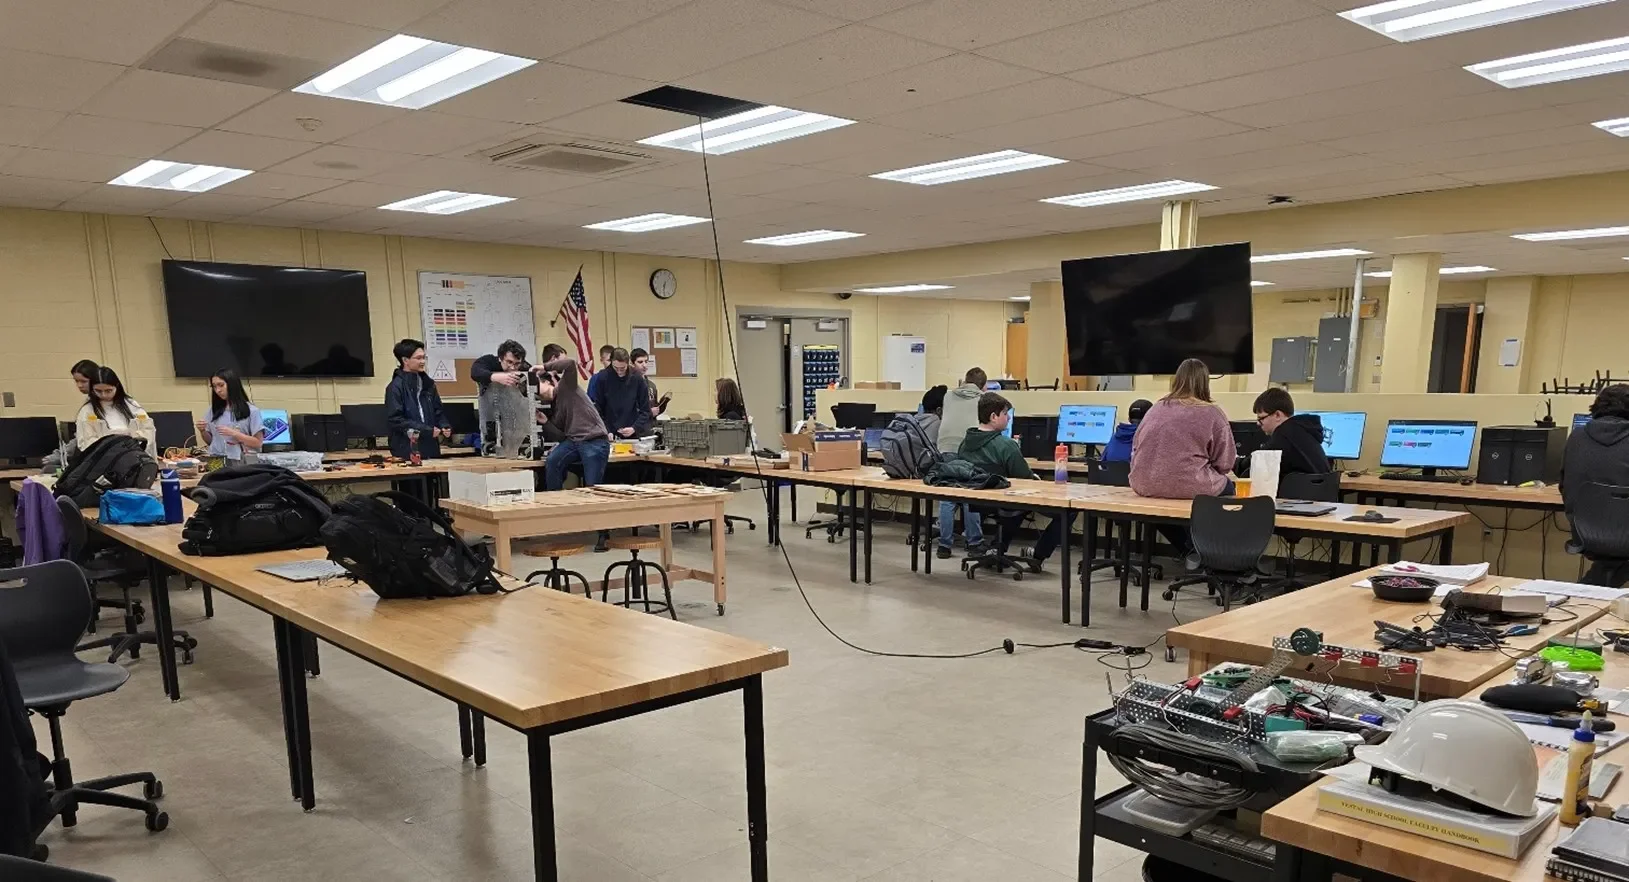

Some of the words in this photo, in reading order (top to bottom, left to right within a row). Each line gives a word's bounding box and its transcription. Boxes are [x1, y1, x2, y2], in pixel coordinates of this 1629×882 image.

[1341, 801, 1364, 812] VESTAL
[1365, 807, 1383, 817] HIGH
[1383, 812, 1409, 824] SCHOOL
[1409, 819, 1439, 832] FACULTY
[1440, 828, 1480, 843] HANDBOOK
